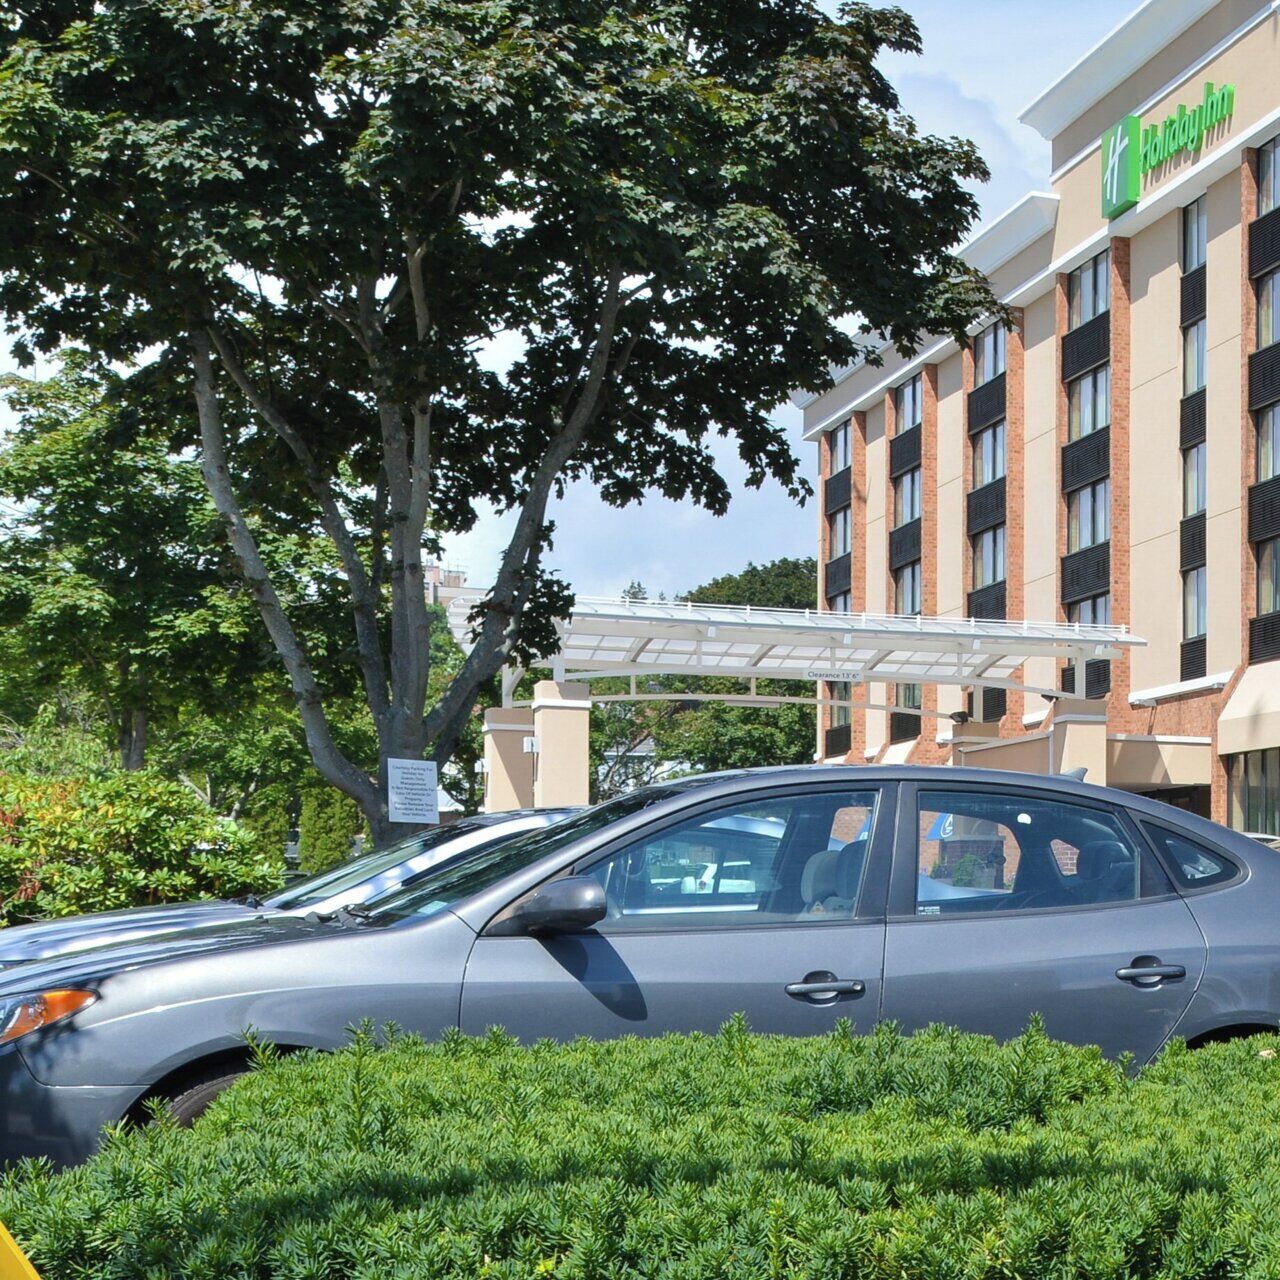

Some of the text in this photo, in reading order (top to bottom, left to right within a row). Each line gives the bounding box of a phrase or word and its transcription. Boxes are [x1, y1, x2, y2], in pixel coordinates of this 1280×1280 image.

[1140, 82, 1234, 174] Holiday Inn
[807, 671, 840, 679] Clearance
